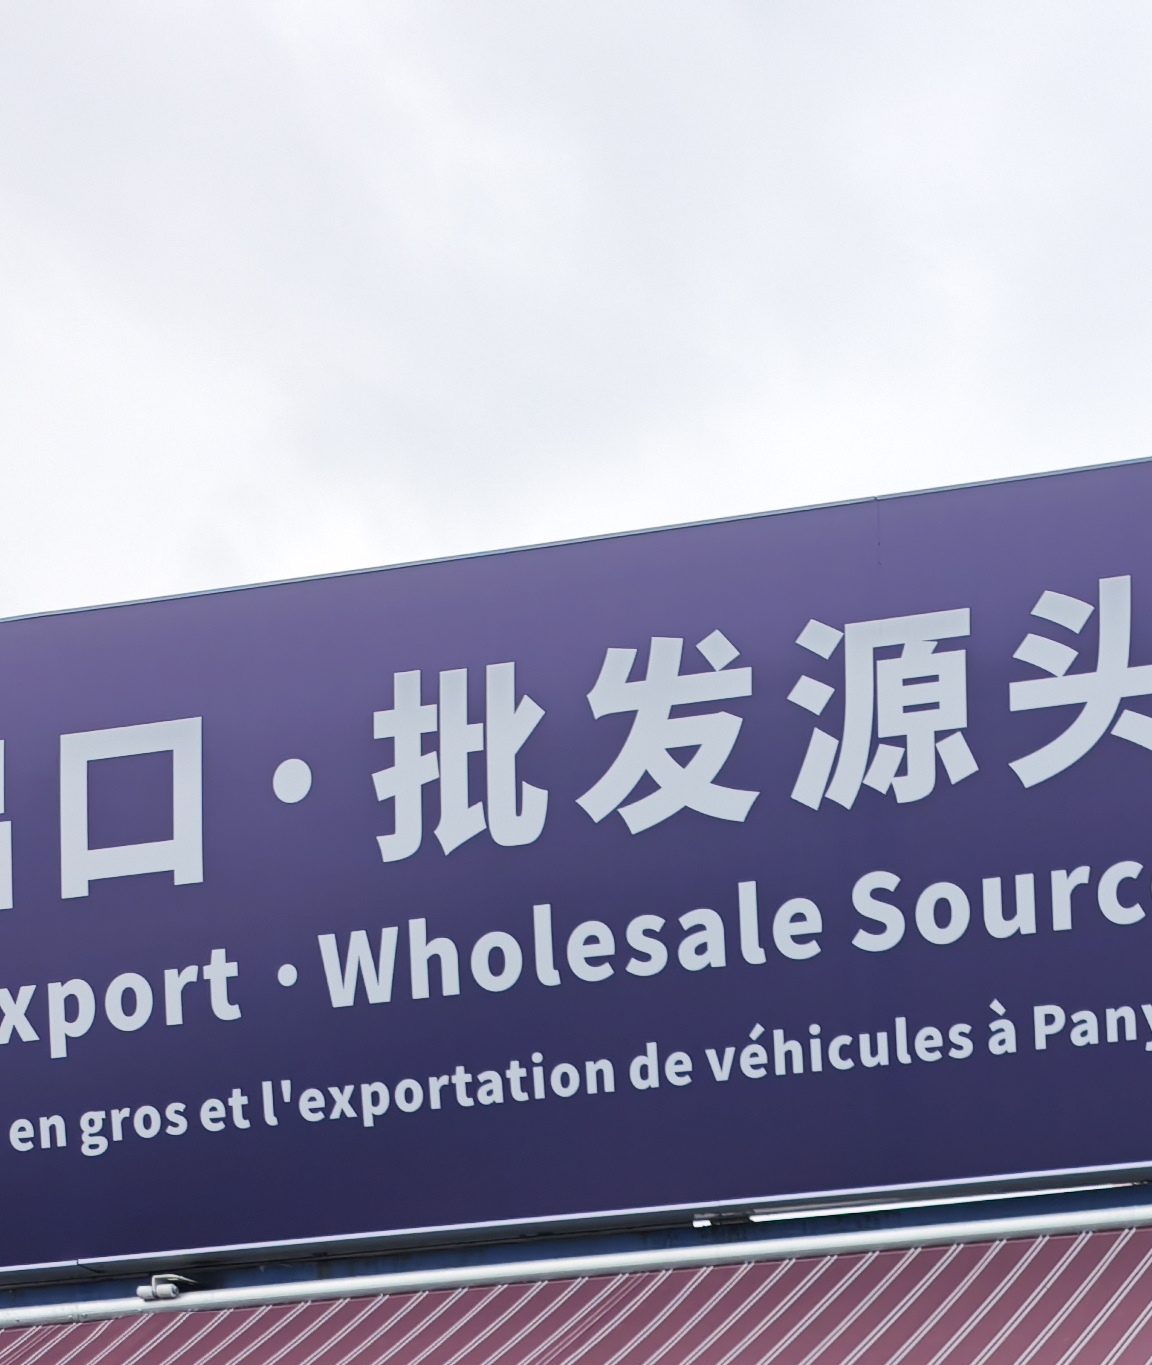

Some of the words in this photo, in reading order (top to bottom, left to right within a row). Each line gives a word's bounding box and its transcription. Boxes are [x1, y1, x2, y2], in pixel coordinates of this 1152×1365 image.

[0, 716, 204, 911] 口
[317, 880, 823, 1008] Wholesale
[9, 1114, 67, 1152] en
[79, 1102, 188, 1157] gros
[200, 1088, 251, 1132] et
[261, 1052, 615, 1128] l'exportation
[629, 1041, 693, 1090] de
[705, 1023, 974, 1082] véhicules
[988, 998, 1017, 1055] à
